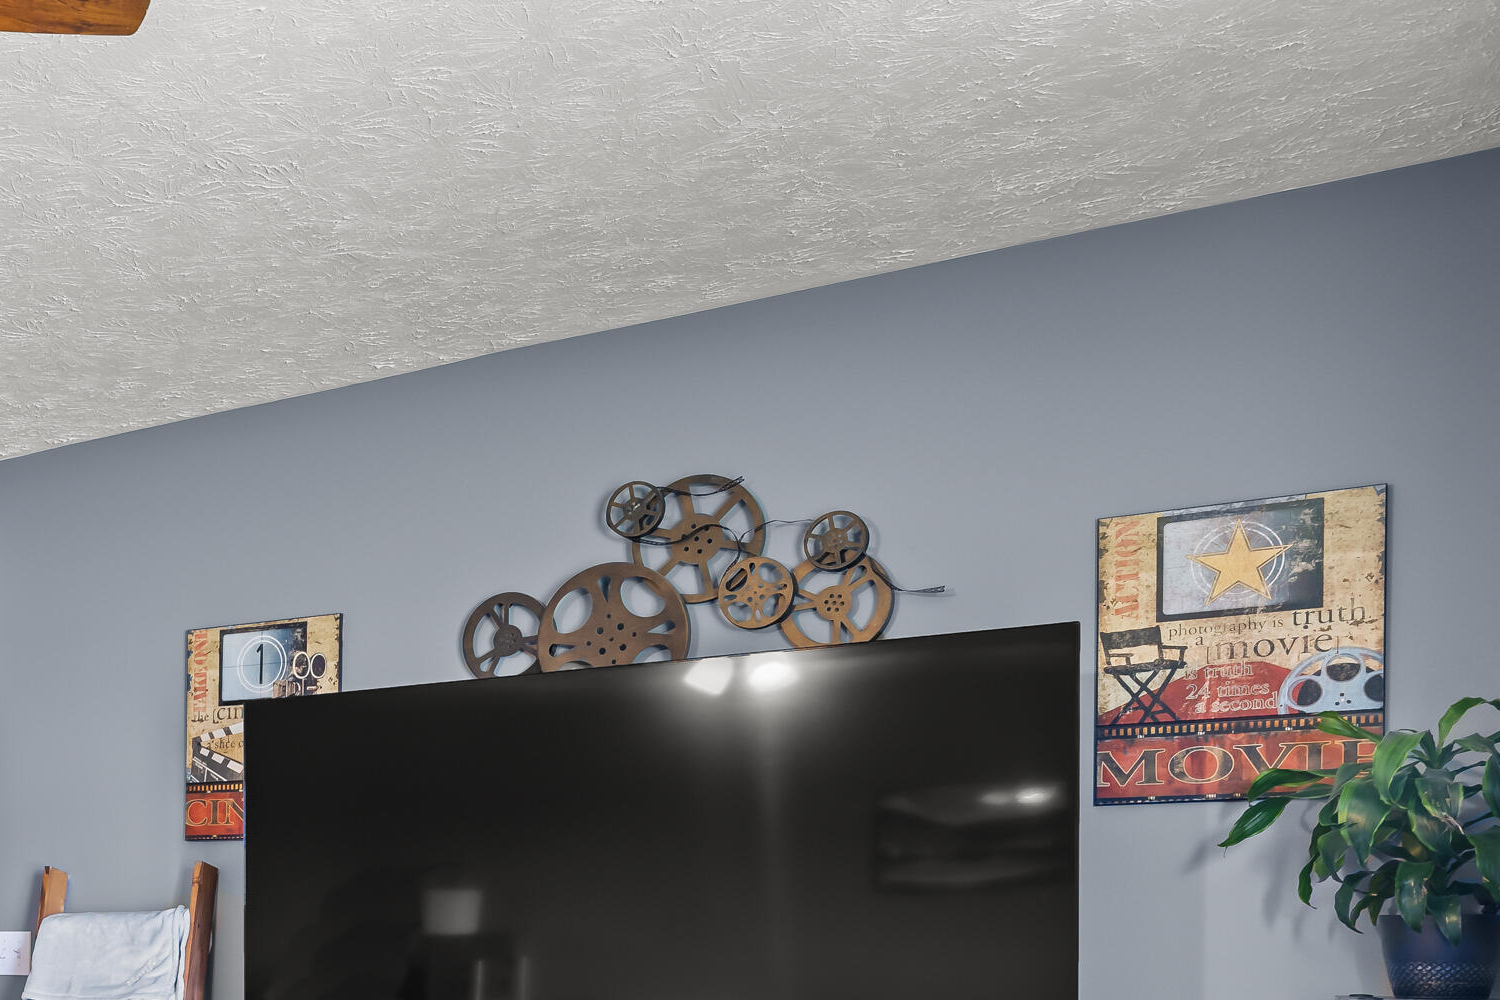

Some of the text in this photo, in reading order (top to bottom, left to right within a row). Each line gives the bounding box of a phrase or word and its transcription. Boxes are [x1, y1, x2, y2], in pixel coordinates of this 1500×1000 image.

[1168, 597, 1367, 641] photography is truth
[1195, 636, 1204, 646] a
[256, 643, 264, 684] 1
[1184, 661, 1254, 680] is truth
[1185, 680, 1270, 700] 24 times
[1211, 691, 1279, 711] second
